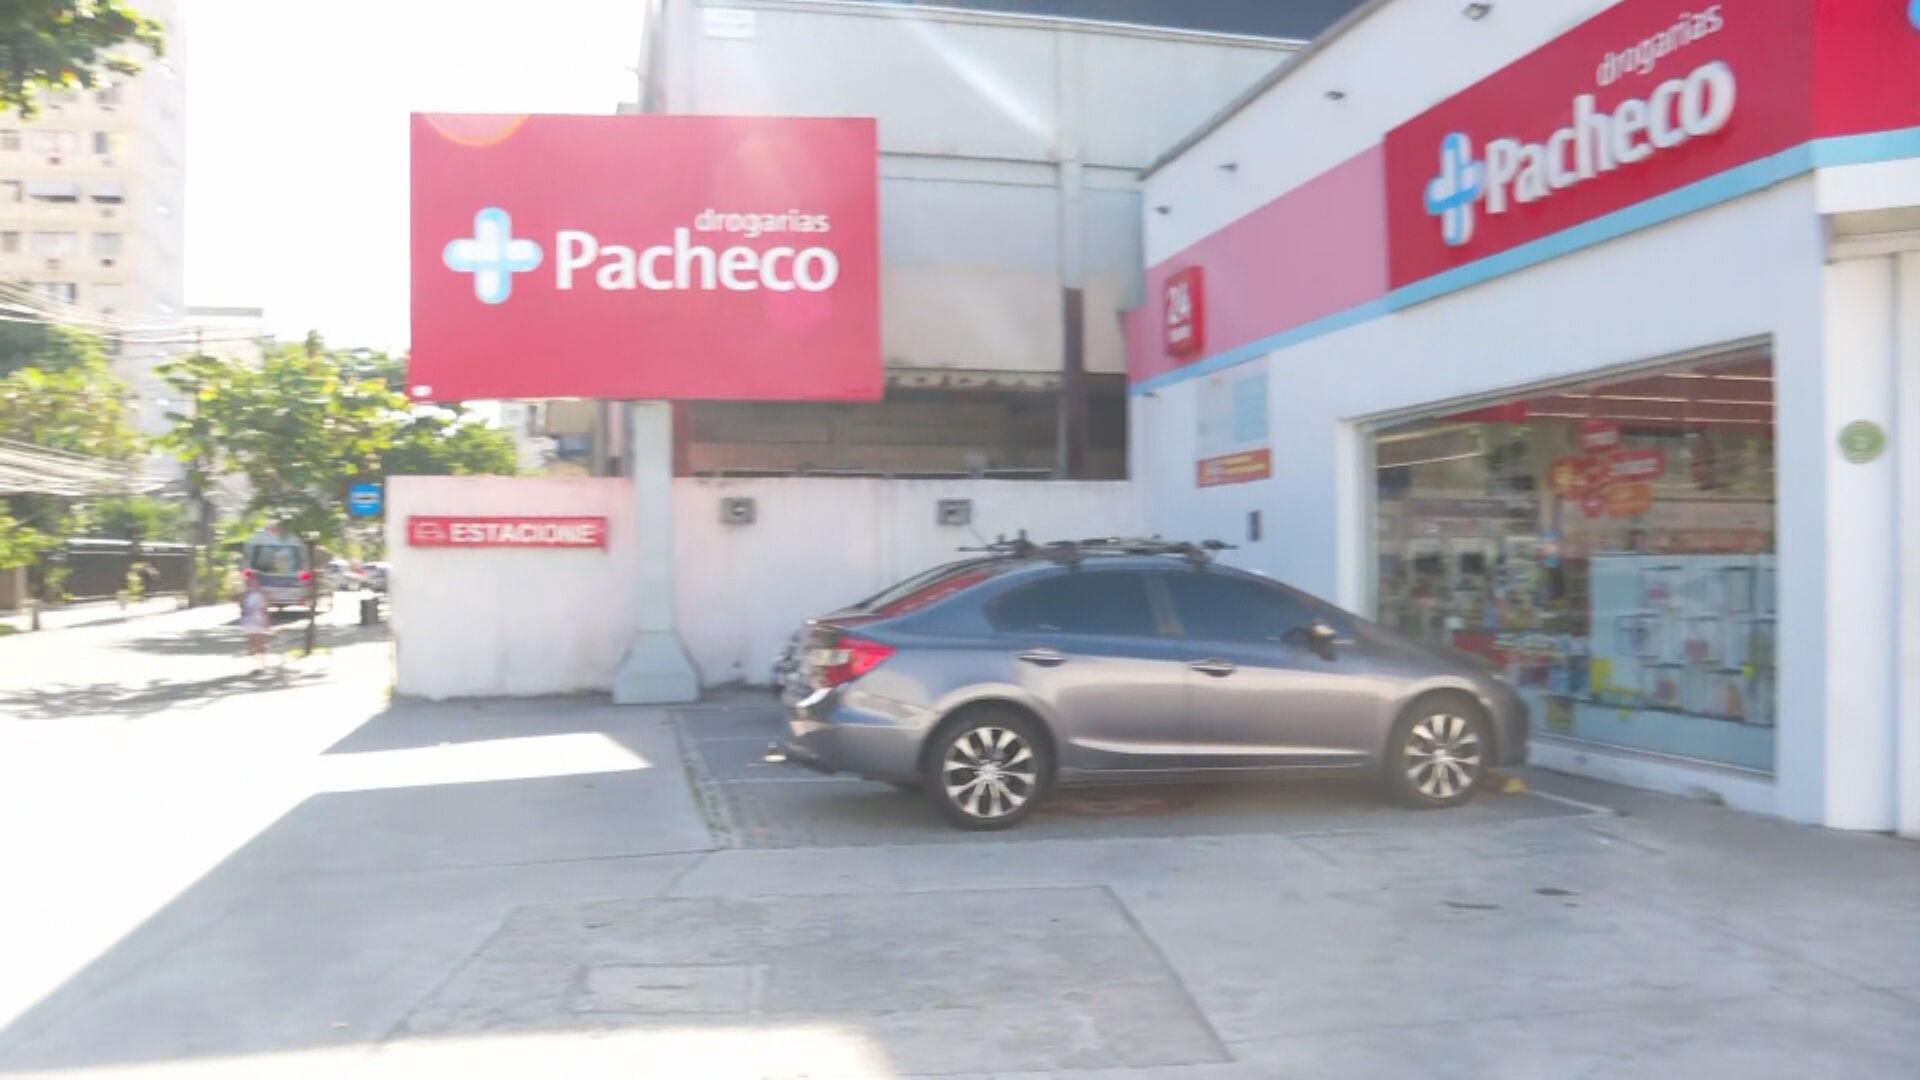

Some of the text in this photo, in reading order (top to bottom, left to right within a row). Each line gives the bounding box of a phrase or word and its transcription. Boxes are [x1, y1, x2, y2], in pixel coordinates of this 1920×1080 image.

[1597, 5, 1723, 86] drogarias
[1484, 60, 1736, 214] Pacheco
[695, 208, 830, 237] drogarias
[555, 228, 839, 292] Pacheco
[450, 522, 598, 543] ESTACIONE
